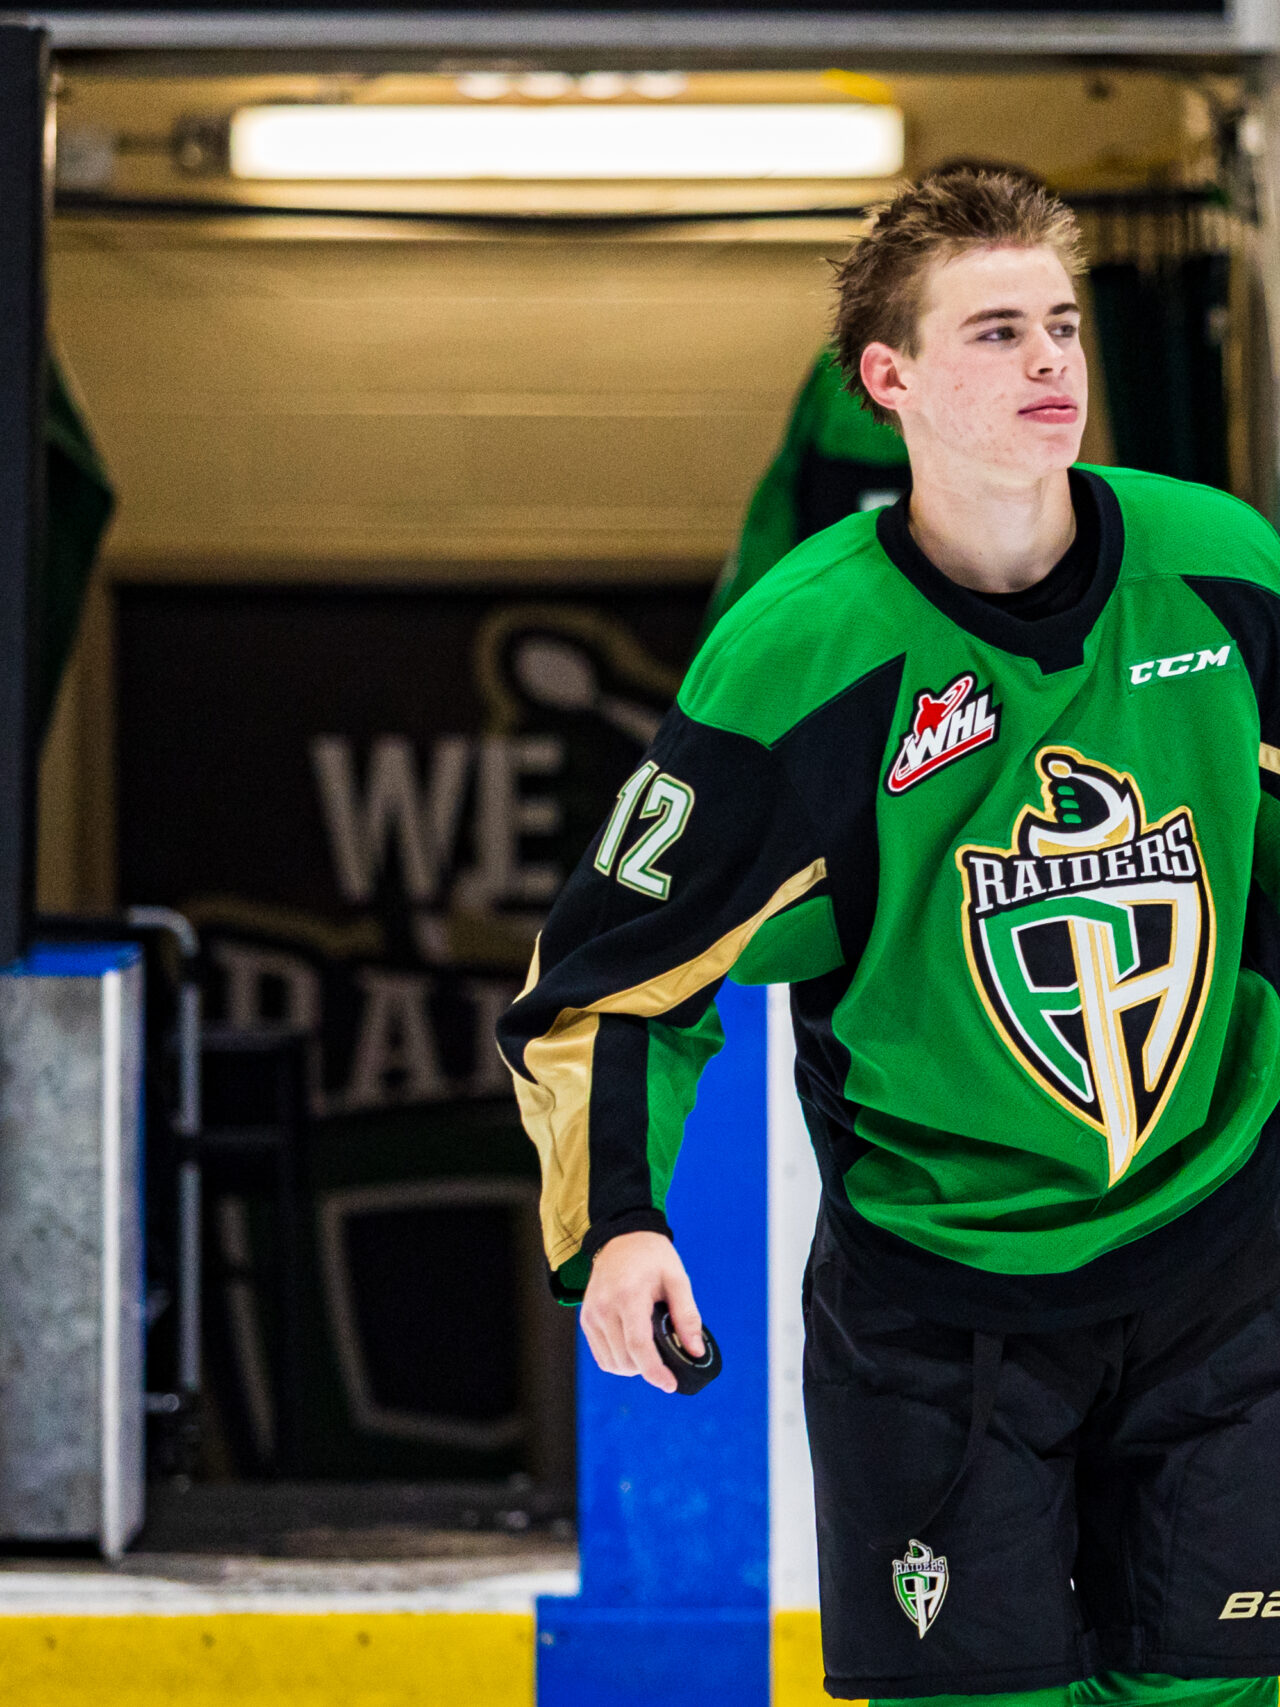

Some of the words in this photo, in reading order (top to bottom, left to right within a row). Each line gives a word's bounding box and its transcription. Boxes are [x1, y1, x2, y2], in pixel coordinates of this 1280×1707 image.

[1129, 645, 1231, 685] CCM
[904, 694, 996, 771] WHL
[594, 760, 695, 901] 12
[968, 819, 1198, 914] RAIDERS
[894, 1559, 946, 1575] RAIDERS
